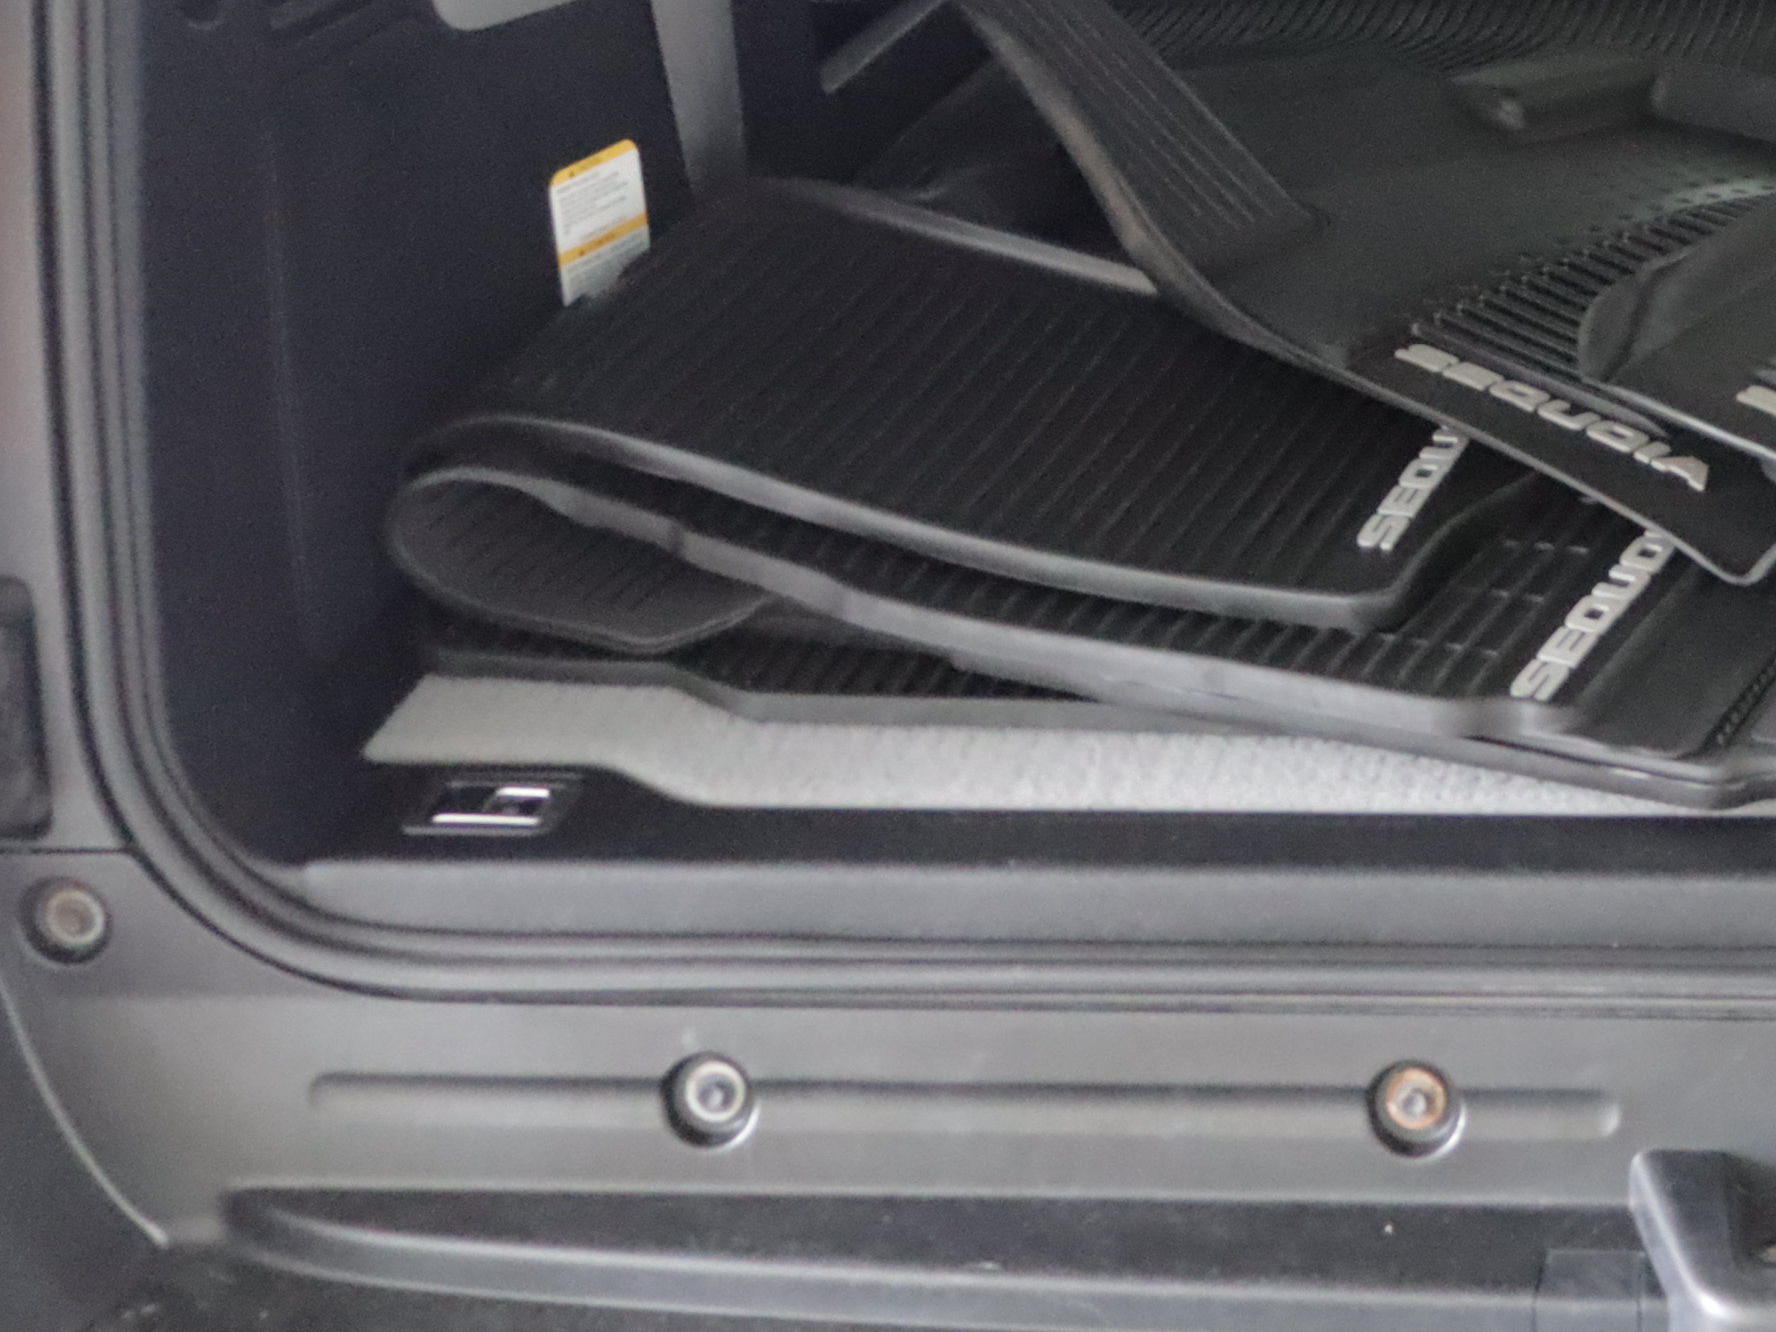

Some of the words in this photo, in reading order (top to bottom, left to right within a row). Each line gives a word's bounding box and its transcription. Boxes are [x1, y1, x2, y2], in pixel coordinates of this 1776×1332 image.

[1356, 426, 1469, 550] SEQU
[1394, 343, 1709, 491] SEQUOIA
[1509, 529, 1676, 701] SEQUO
